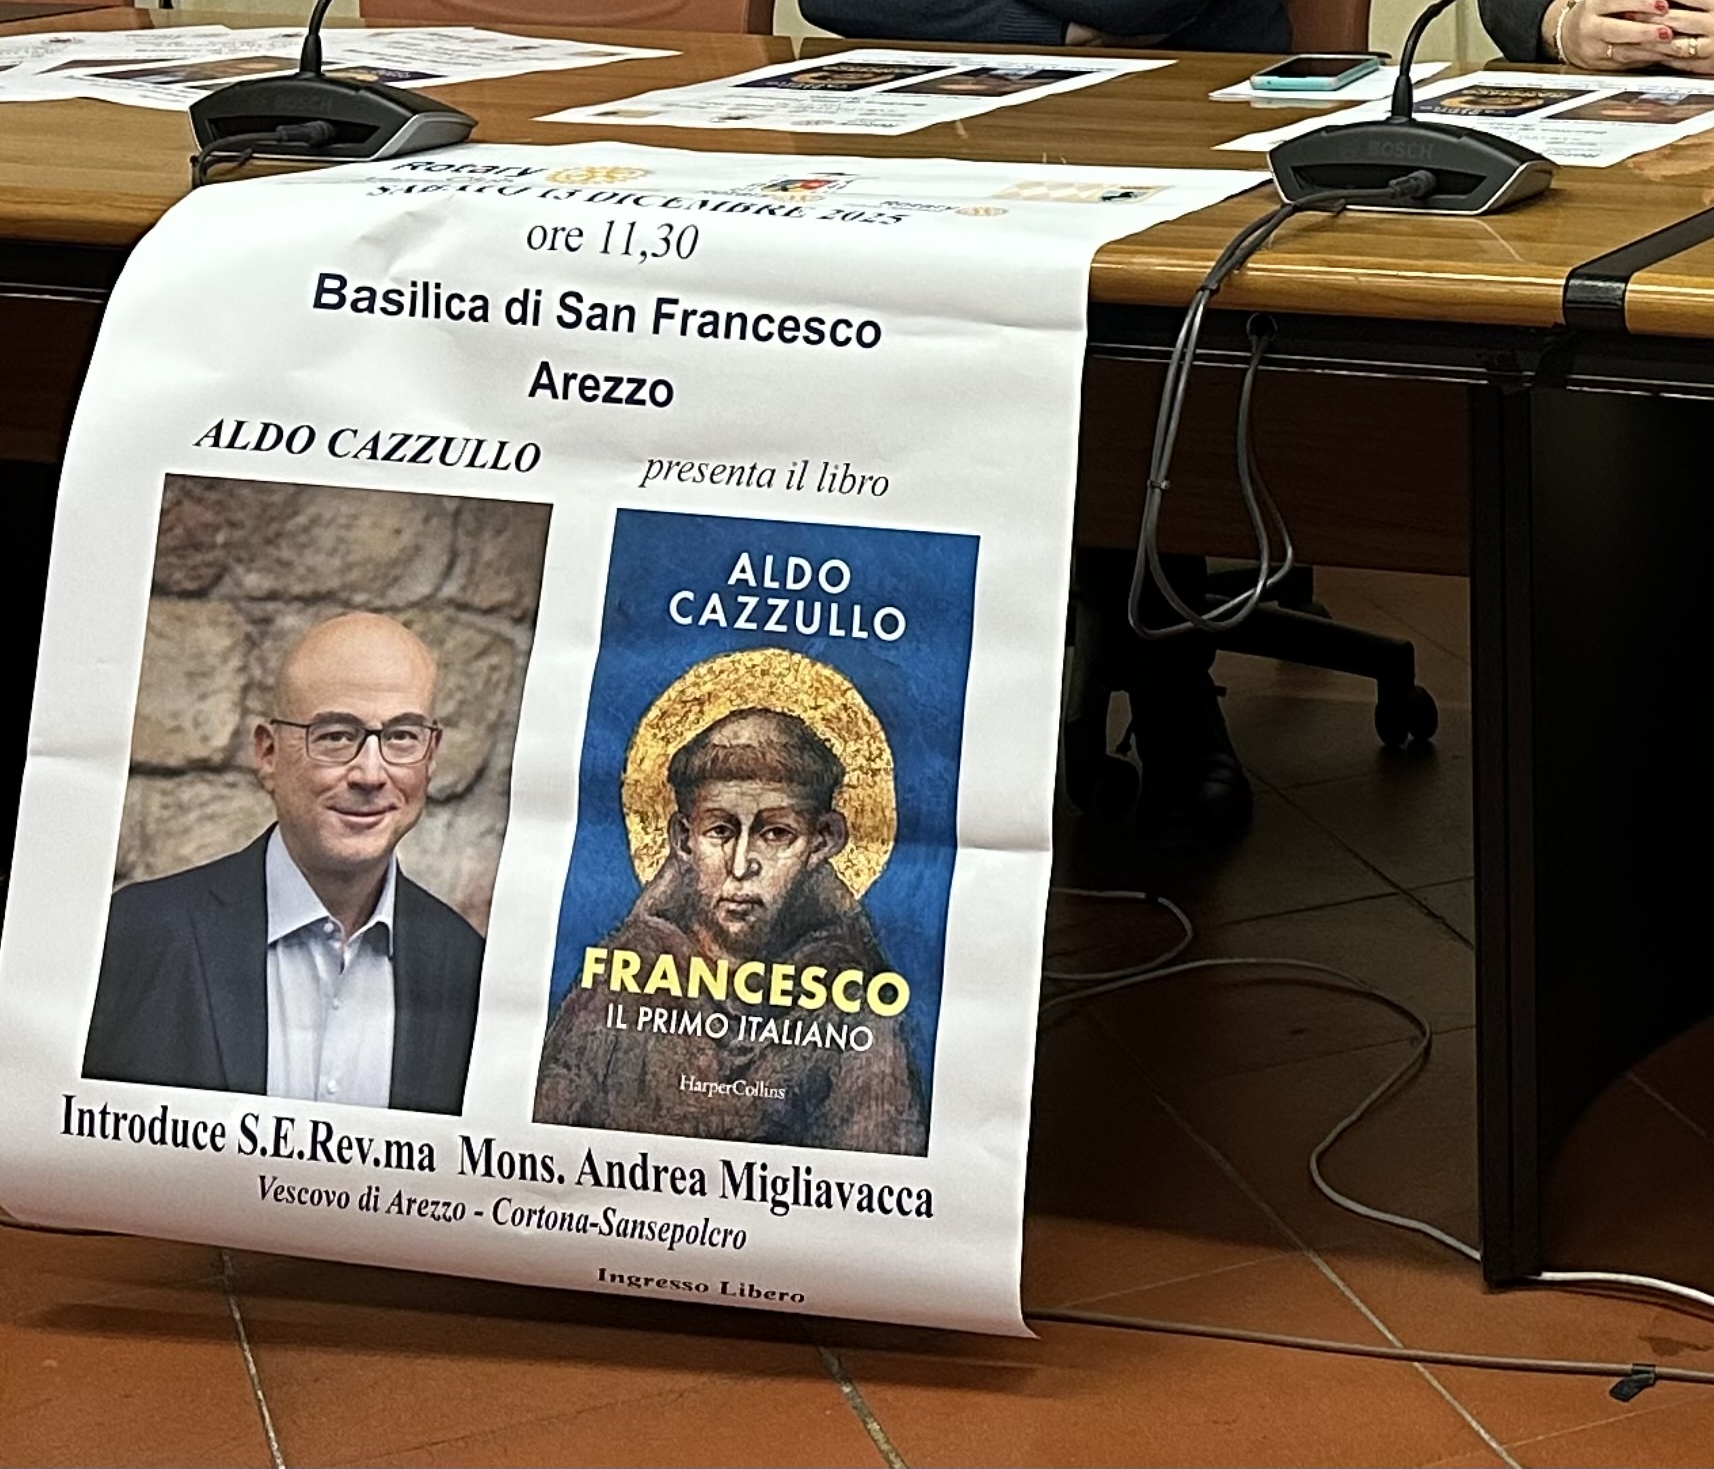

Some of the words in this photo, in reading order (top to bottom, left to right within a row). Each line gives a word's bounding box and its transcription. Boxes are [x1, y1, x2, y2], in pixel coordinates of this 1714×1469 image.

[391, 160, 547, 178] Rotary
[1369, 140, 1434, 159] BOSCH
[527, 224, 584, 252] ore
[600, 220, 699, 265] 11,30
[312, 272, 490, 323] Basilica
[504, 287, 542, 327] di
[556, 289, 636, 334] San
[652, 297, 882, 349] Francesco
[528, 360, 675, 408] Arezzo
[195, 418, 316, 455] ALDO
[327, 427, 541, 473] CAZZULLO
[640, 456, 777, 490] presenta
[785, 460, 808, 492] il
[816, 462, 890, 498] libro
[728, 553, 850, 594] ALDO
[669, 590, 906, 641] CAZZULLO
[580, 946, 911, 1016] FRANCESCO
[606, 1003, 626, 1029] IL
[636, 1007, 728, 1039] PRIMO
[737, 1016, 874, 1052] ITALIANO
[678, 1073, 786, 1100] HarperCollins
[61, 1095, 227, 1152] Introduce
[237, 1113, 436, 1172] S.E.Rev.ma
[457, 1135, 565, 1185] Mons.
[574, 1147, 708, 1198] Andrea
[719, 1160, 935, 1218] Migliavacca
[258, 1175, 351, 1211] Vescovo
[358, 1185, 380, 1214] di
[385, 1189, 466, 1223] Arezzo
[492, 1197, 748, 1252] Cortona-Sansepolcro
[598, 1268, 709, 1296] Ingresso
[719, 1281, 805, 1304] Libero
